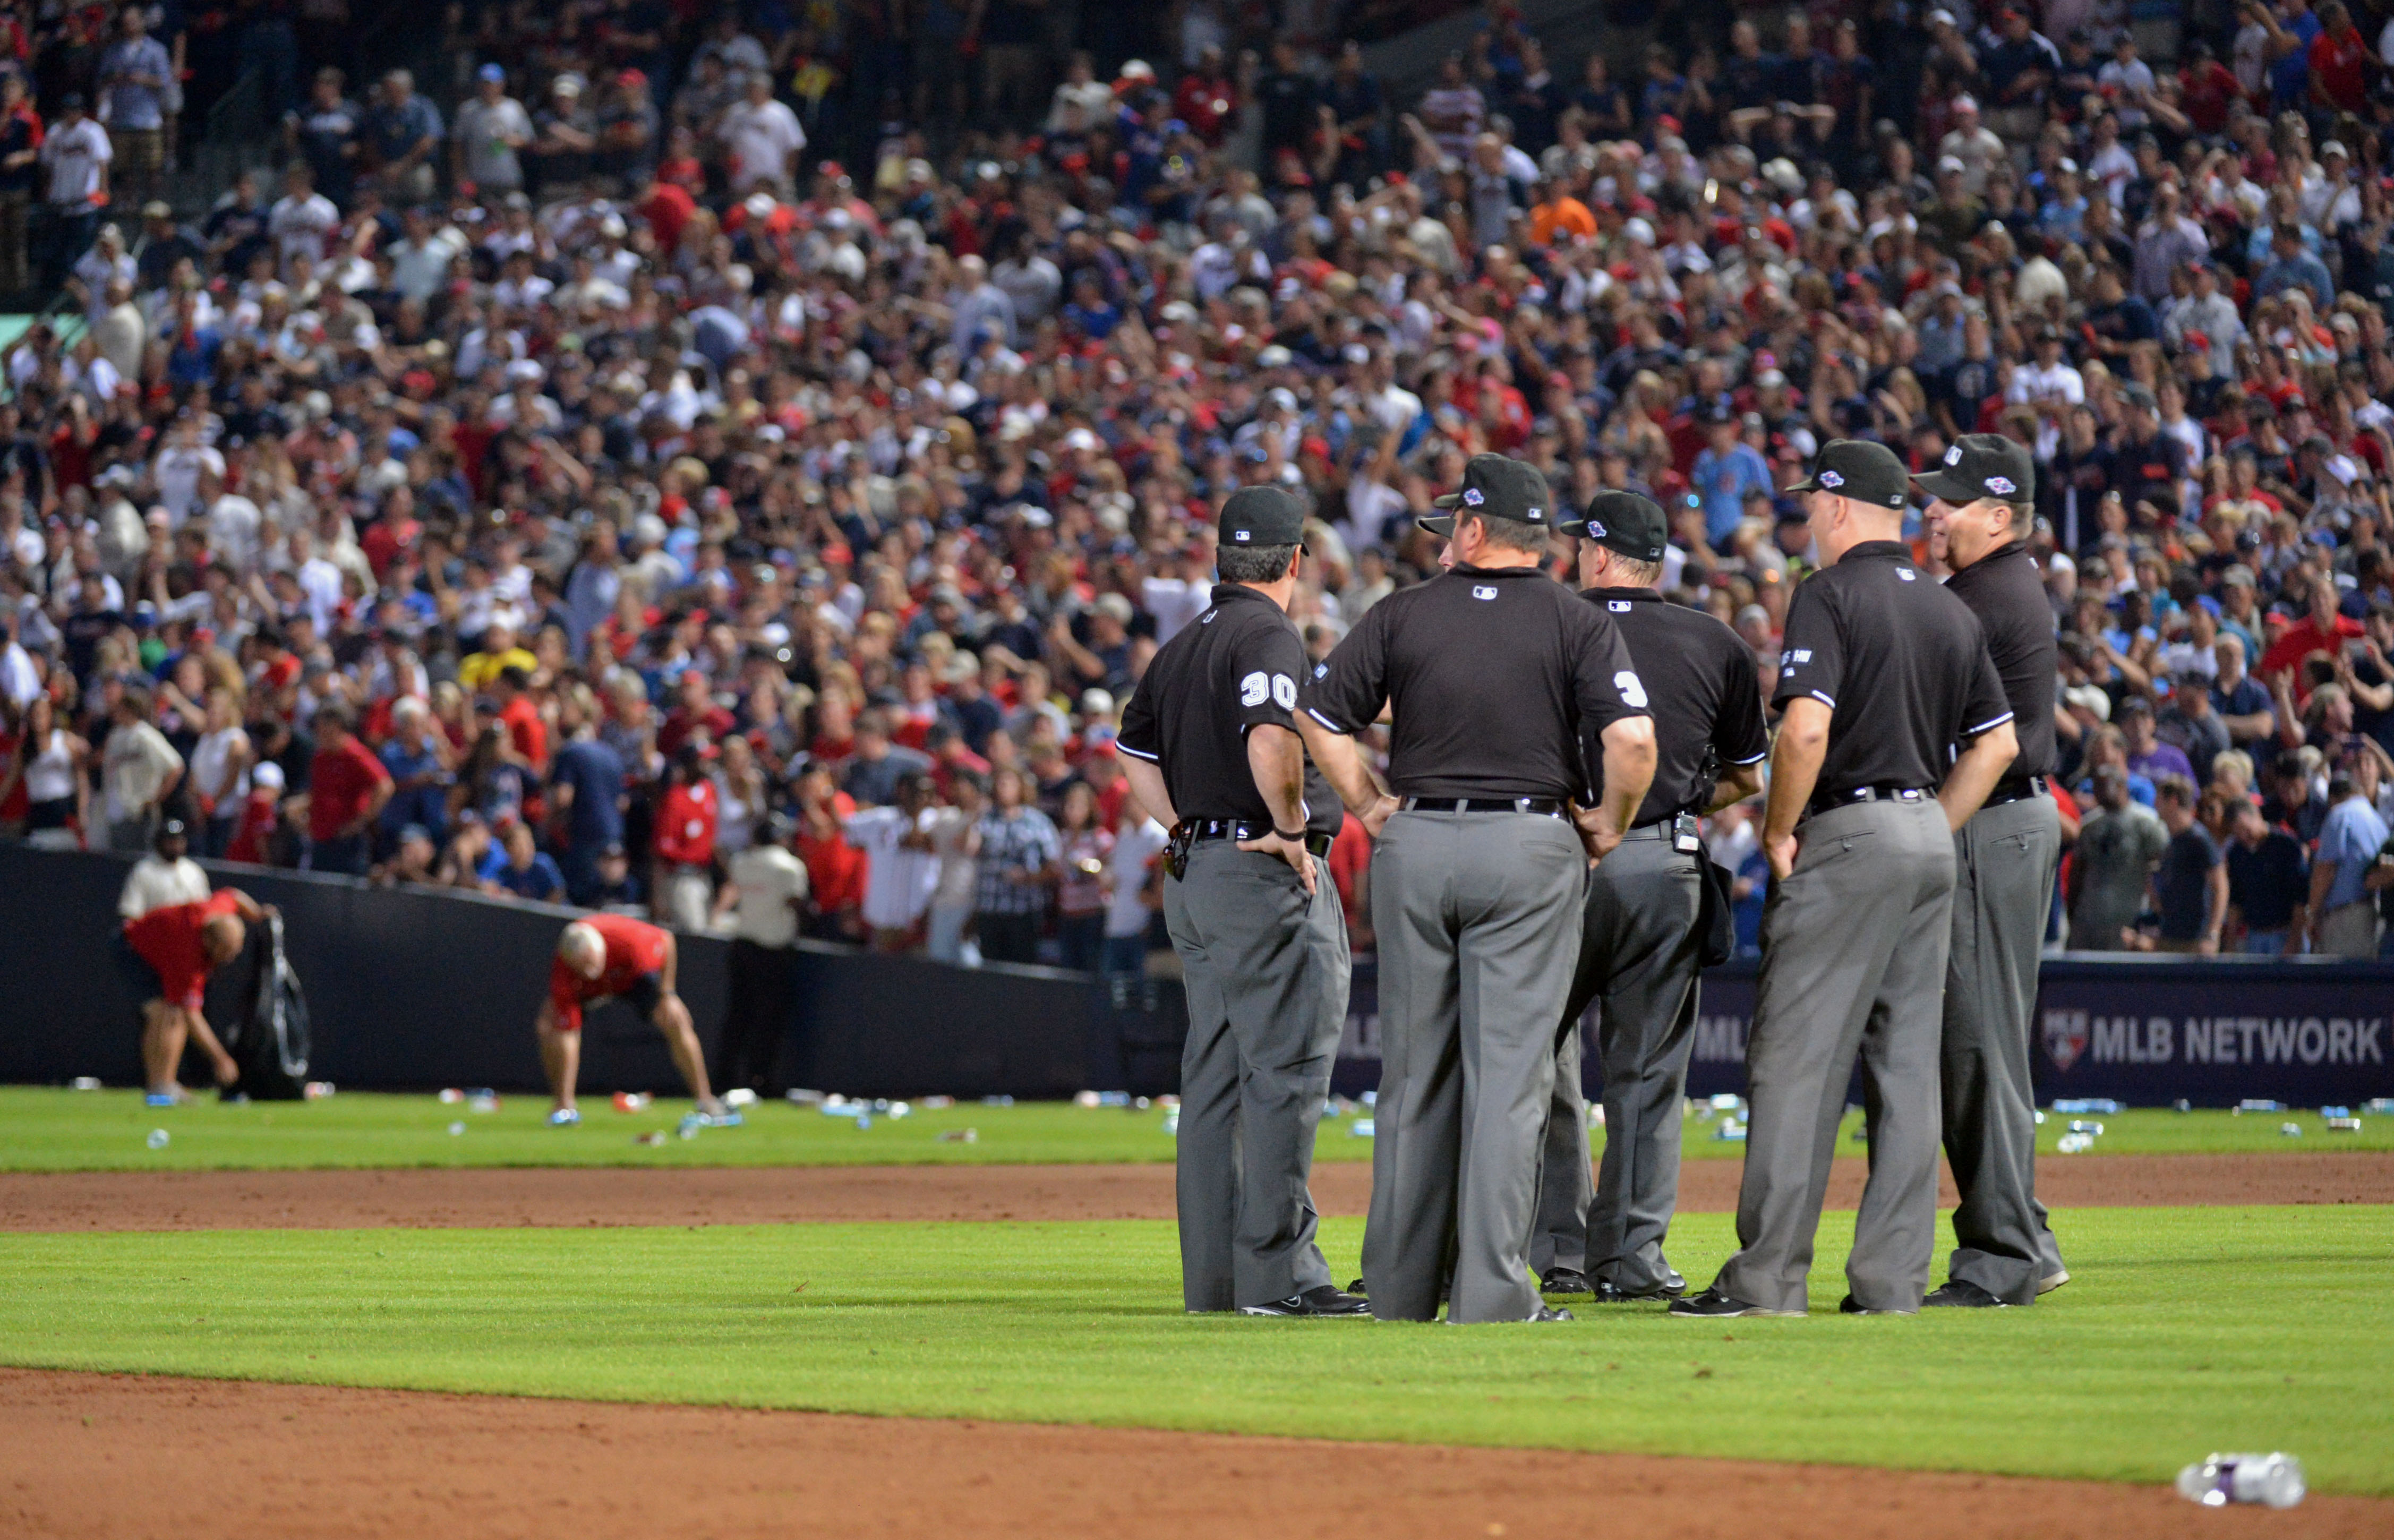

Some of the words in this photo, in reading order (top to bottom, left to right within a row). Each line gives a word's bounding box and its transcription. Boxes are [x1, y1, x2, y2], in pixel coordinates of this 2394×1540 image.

[1241, 671, 1297, 711] 30
[1614, 671, 1648, 707] 3
[2092, 1016, 2172, 1064] MLB
[2184, 1016, 2383, 1064] NETWORK
